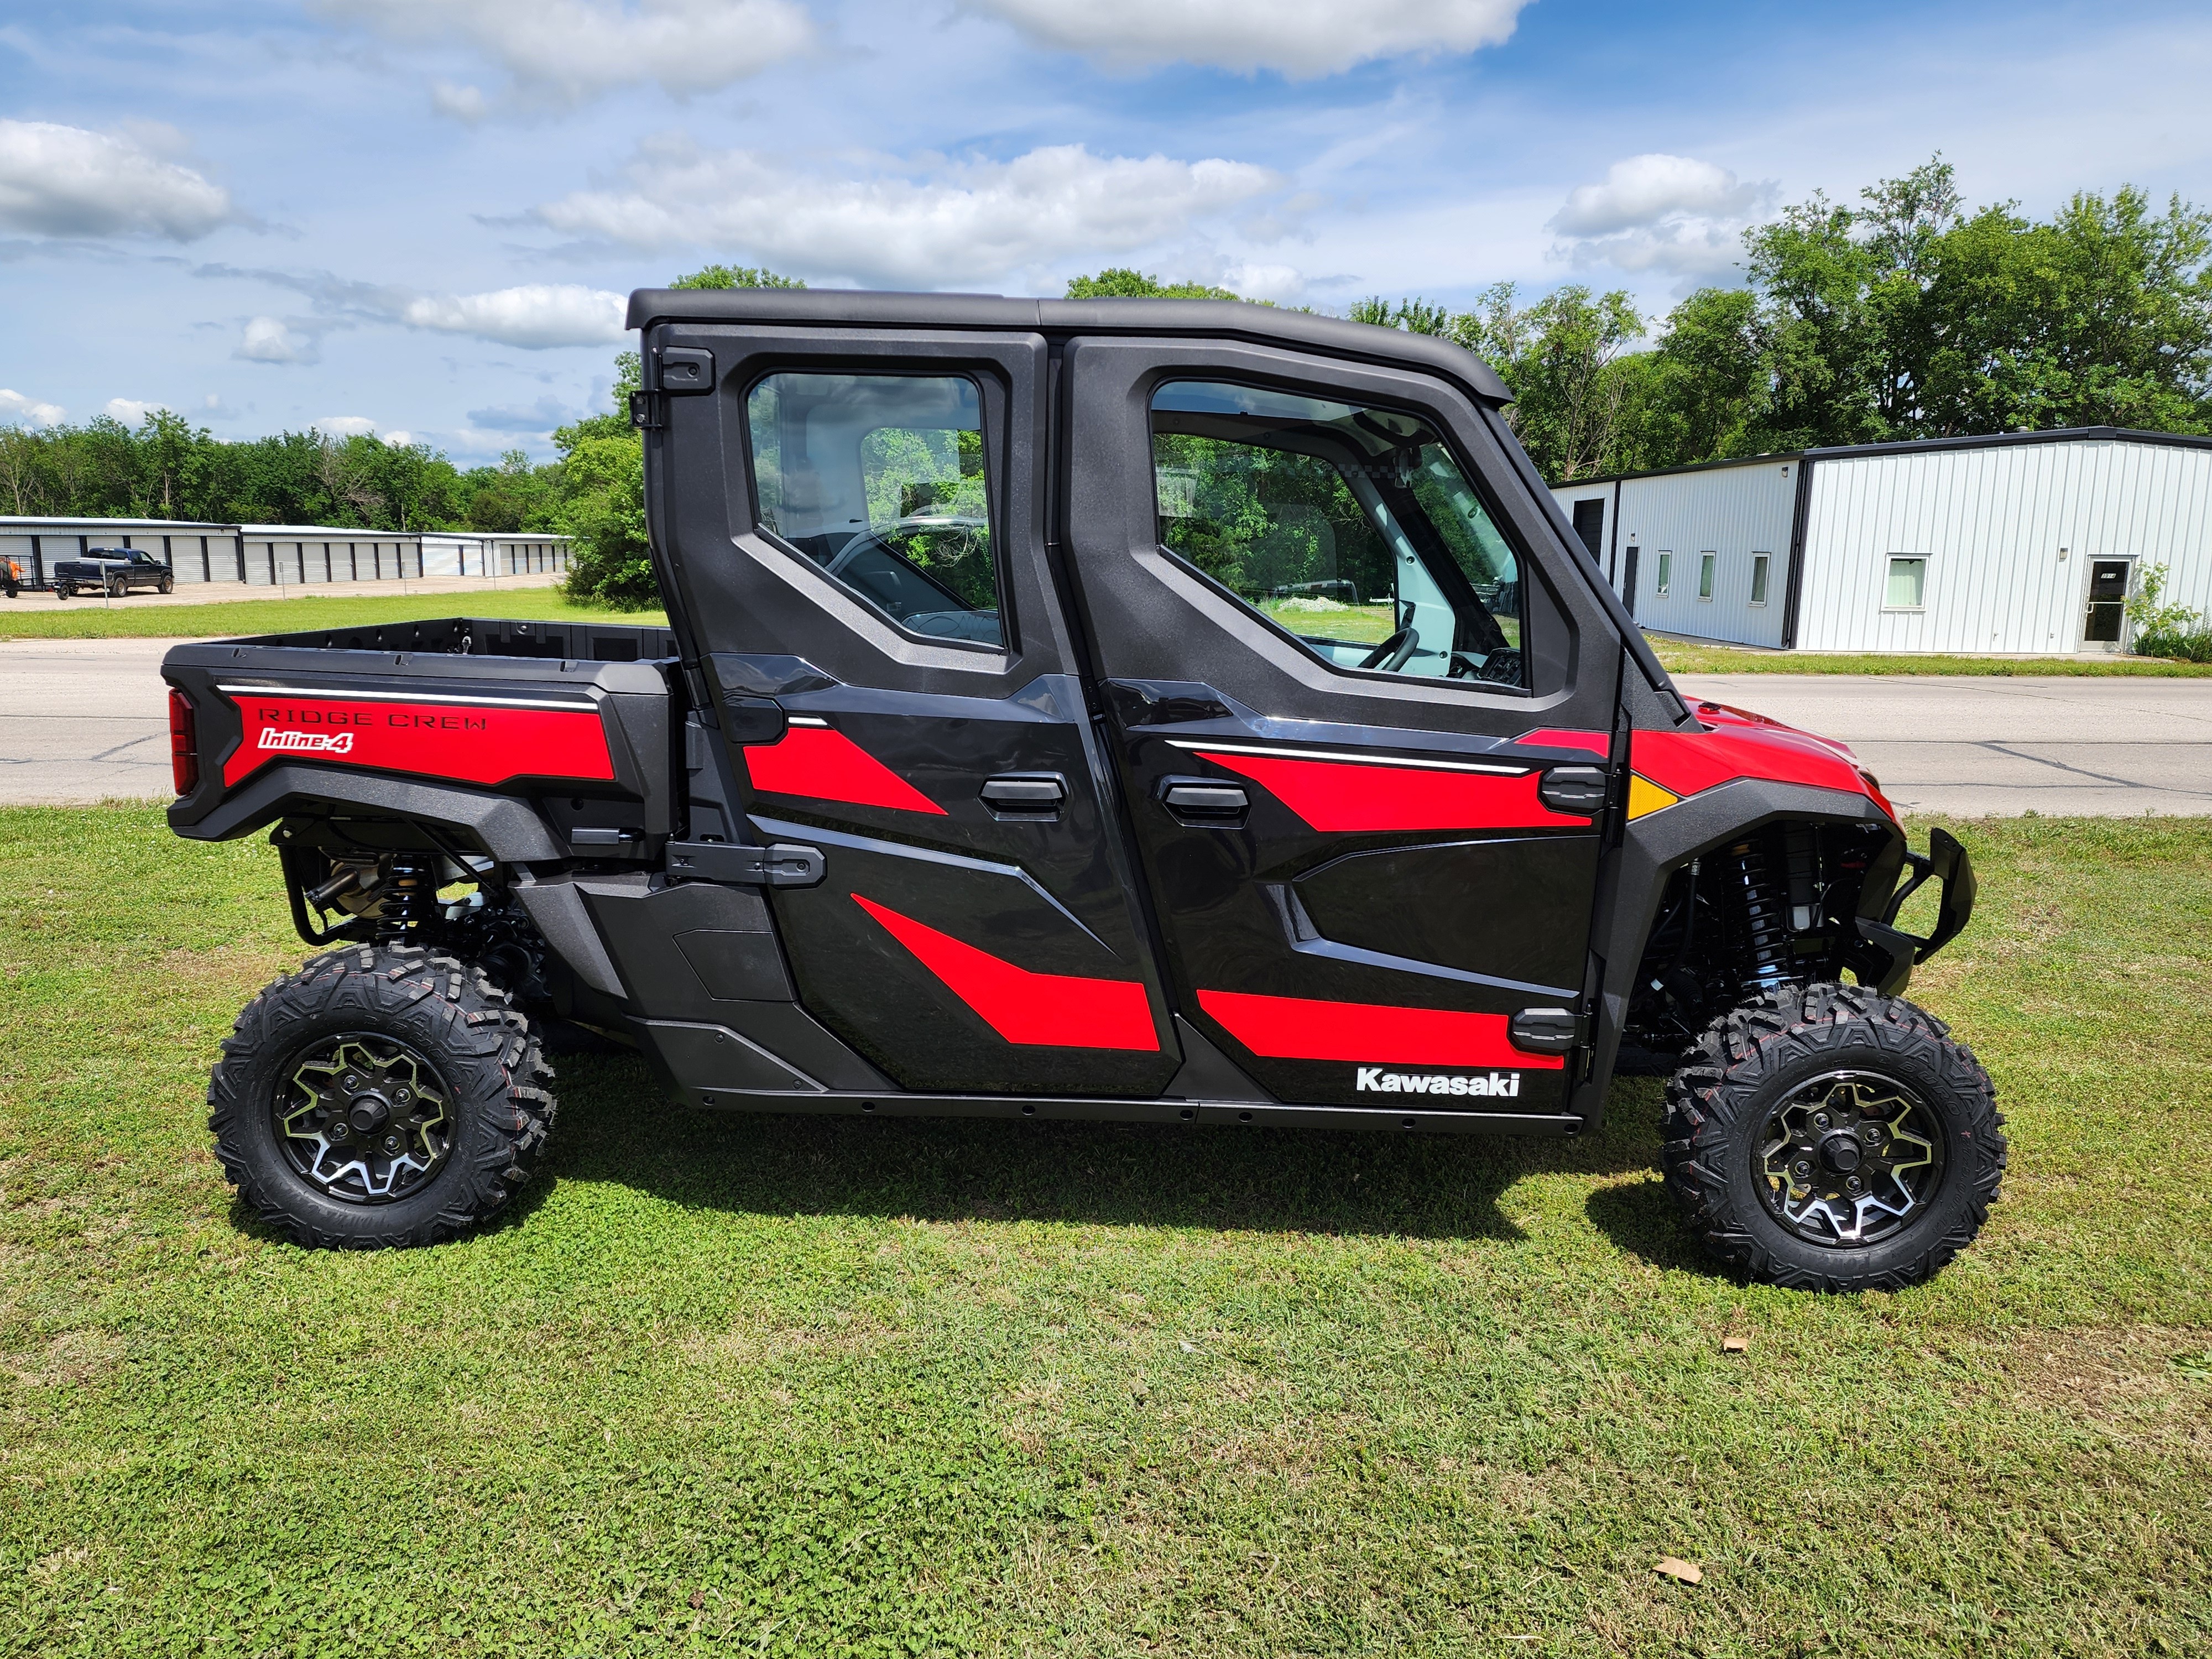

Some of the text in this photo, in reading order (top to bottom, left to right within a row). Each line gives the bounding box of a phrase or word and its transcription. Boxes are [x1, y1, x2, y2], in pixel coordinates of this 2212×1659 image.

[259, 708, 486, 731] RIDGE CREW
[258, 728, 353, 753] Inline-4
[1356, 1066, 1520, 1097] Kawasaki
[1897, 1061, 1961, 1115] DURO
